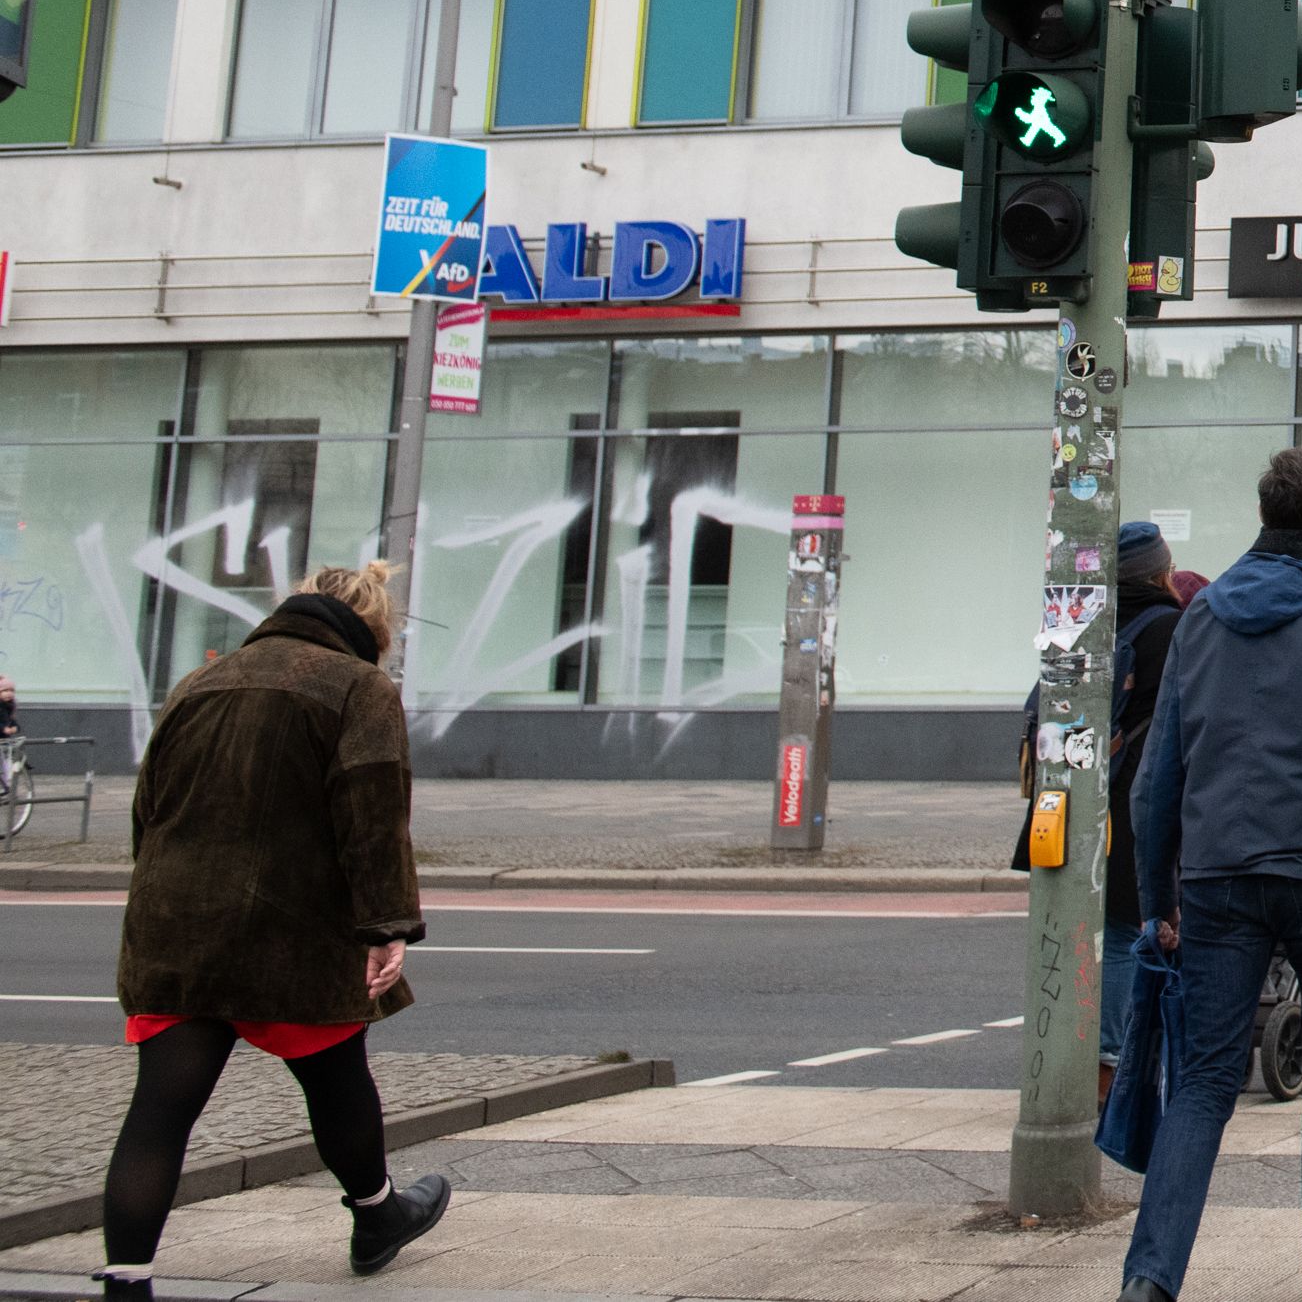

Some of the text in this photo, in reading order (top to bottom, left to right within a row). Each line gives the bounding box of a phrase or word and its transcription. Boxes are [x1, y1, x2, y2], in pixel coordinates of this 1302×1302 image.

[385, 195, 449, 219] ZEIT FÜR
[384, 214, 480, 239] DEUTSCHLAND.
[436, 261, 470, 283] AfD
[478, 218, 746, 303] ALDI
[1031, 282, 1048, 294] F2
[783, 747, 802, 824] Velodeath
